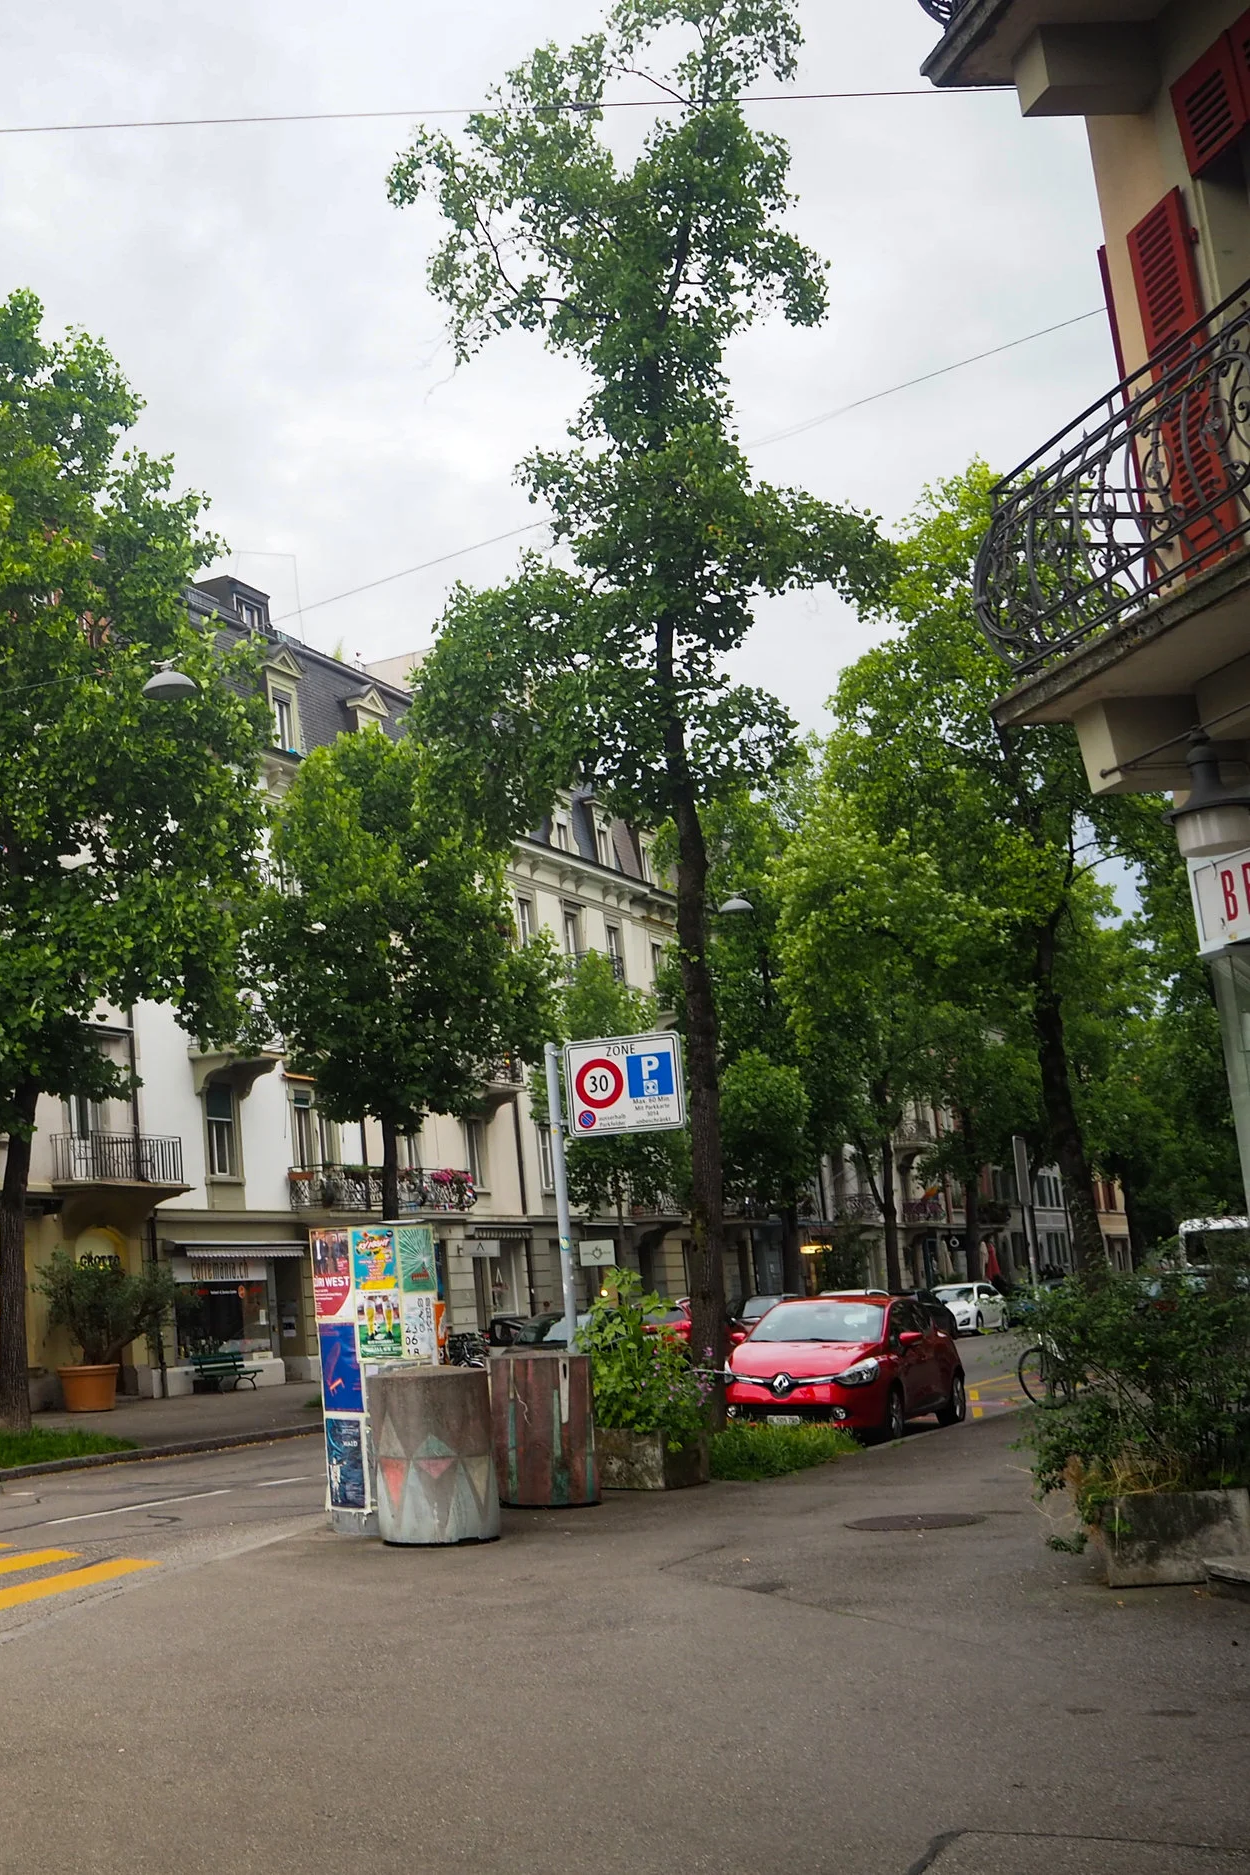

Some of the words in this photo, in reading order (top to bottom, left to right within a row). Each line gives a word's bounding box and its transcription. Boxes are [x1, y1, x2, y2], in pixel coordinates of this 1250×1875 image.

[606, 1044, 636, 1057] ZONE
[589, 1075, 609, 1093] 30
[325, 1275, 350, 1287] WEST
[405, 1336, 418, 1345] 06
